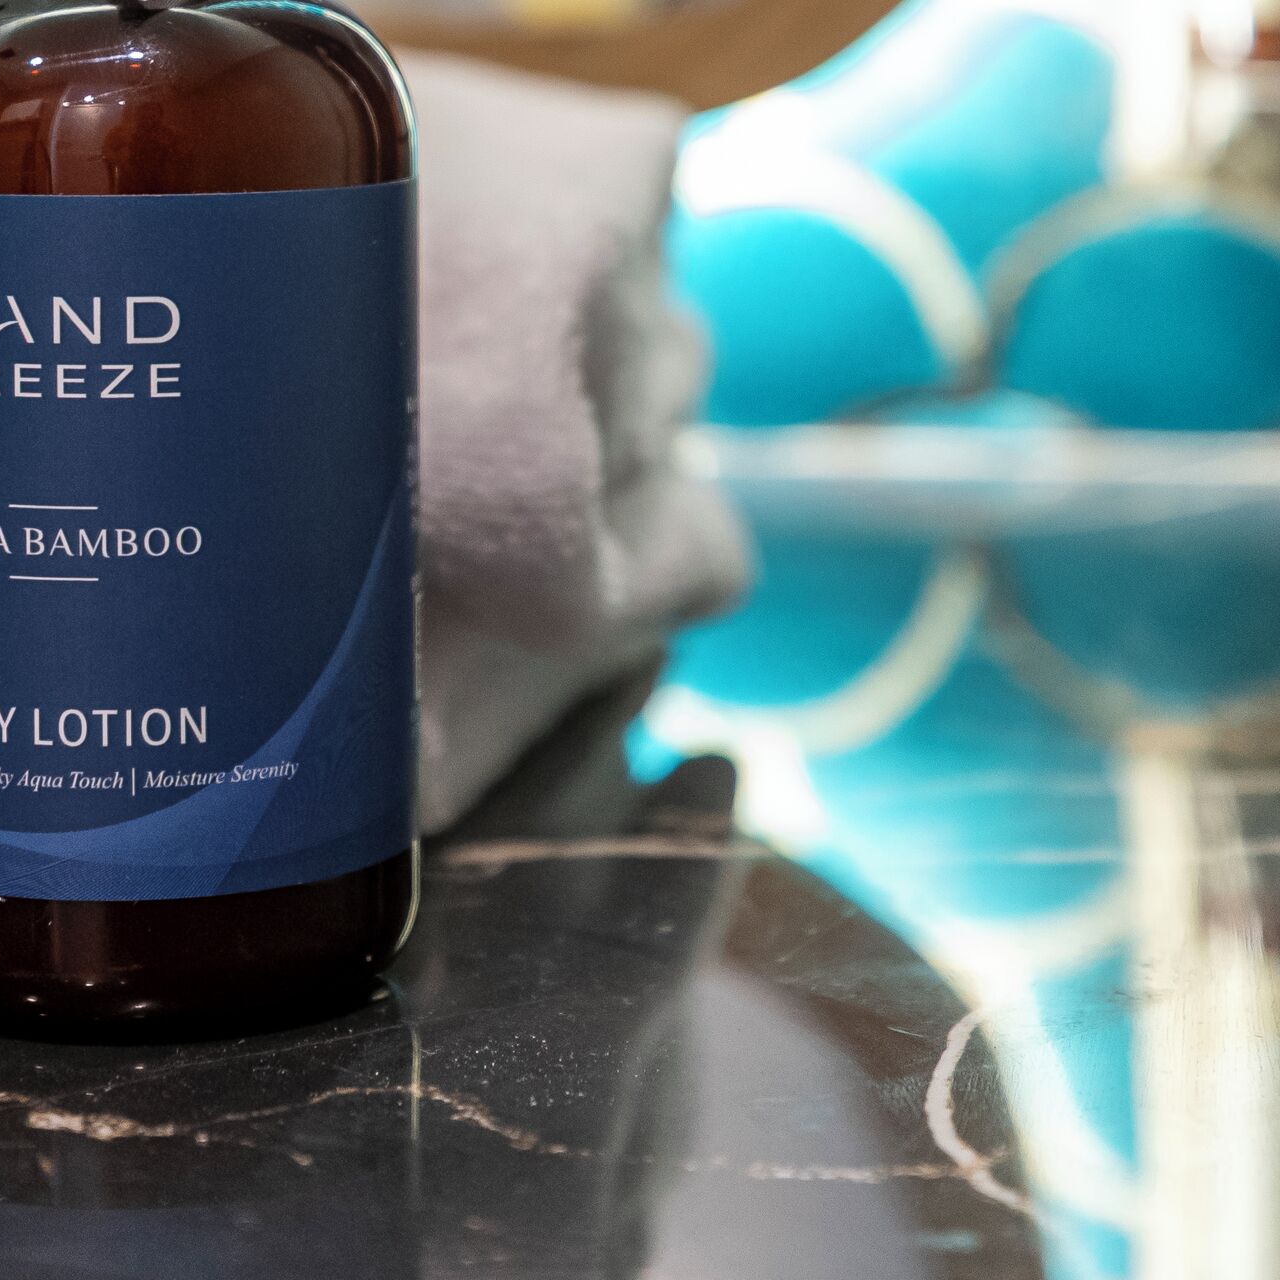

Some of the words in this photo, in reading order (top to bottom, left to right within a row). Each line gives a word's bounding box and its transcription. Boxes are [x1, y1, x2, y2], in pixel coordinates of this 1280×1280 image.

[22, 525, 203, 560] BAMBOO
[32, 705, 208, 749] LOTION
[16, 769, 63, 792] Aqua
[69, 770, 125, 790] Touch
[142, 768, 226, 790] Moisture
[230, 759, 300, 786] Serenity
